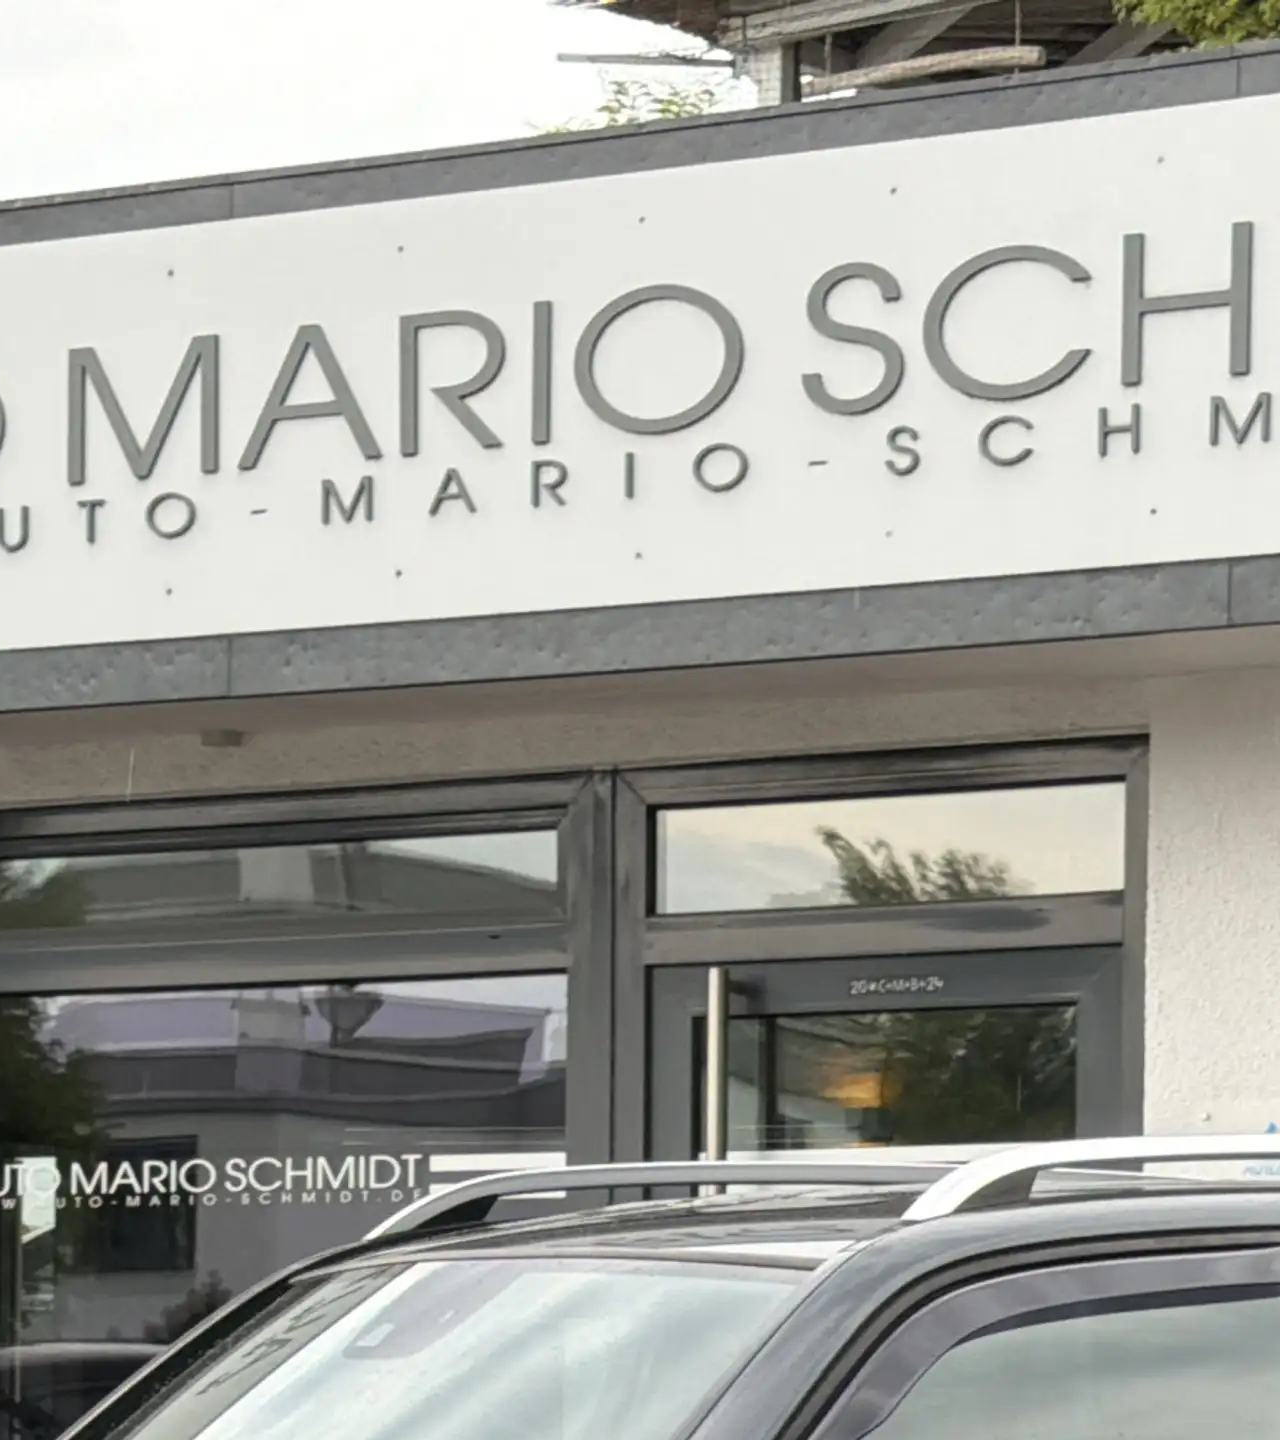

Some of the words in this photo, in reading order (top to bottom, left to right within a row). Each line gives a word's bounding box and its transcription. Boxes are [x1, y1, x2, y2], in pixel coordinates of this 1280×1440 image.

[68, 284, 745, 487] MARIO
[70, 1157, 218, 1195] MARIO
[224, 1153, 424, 1193] SCHMIDT
